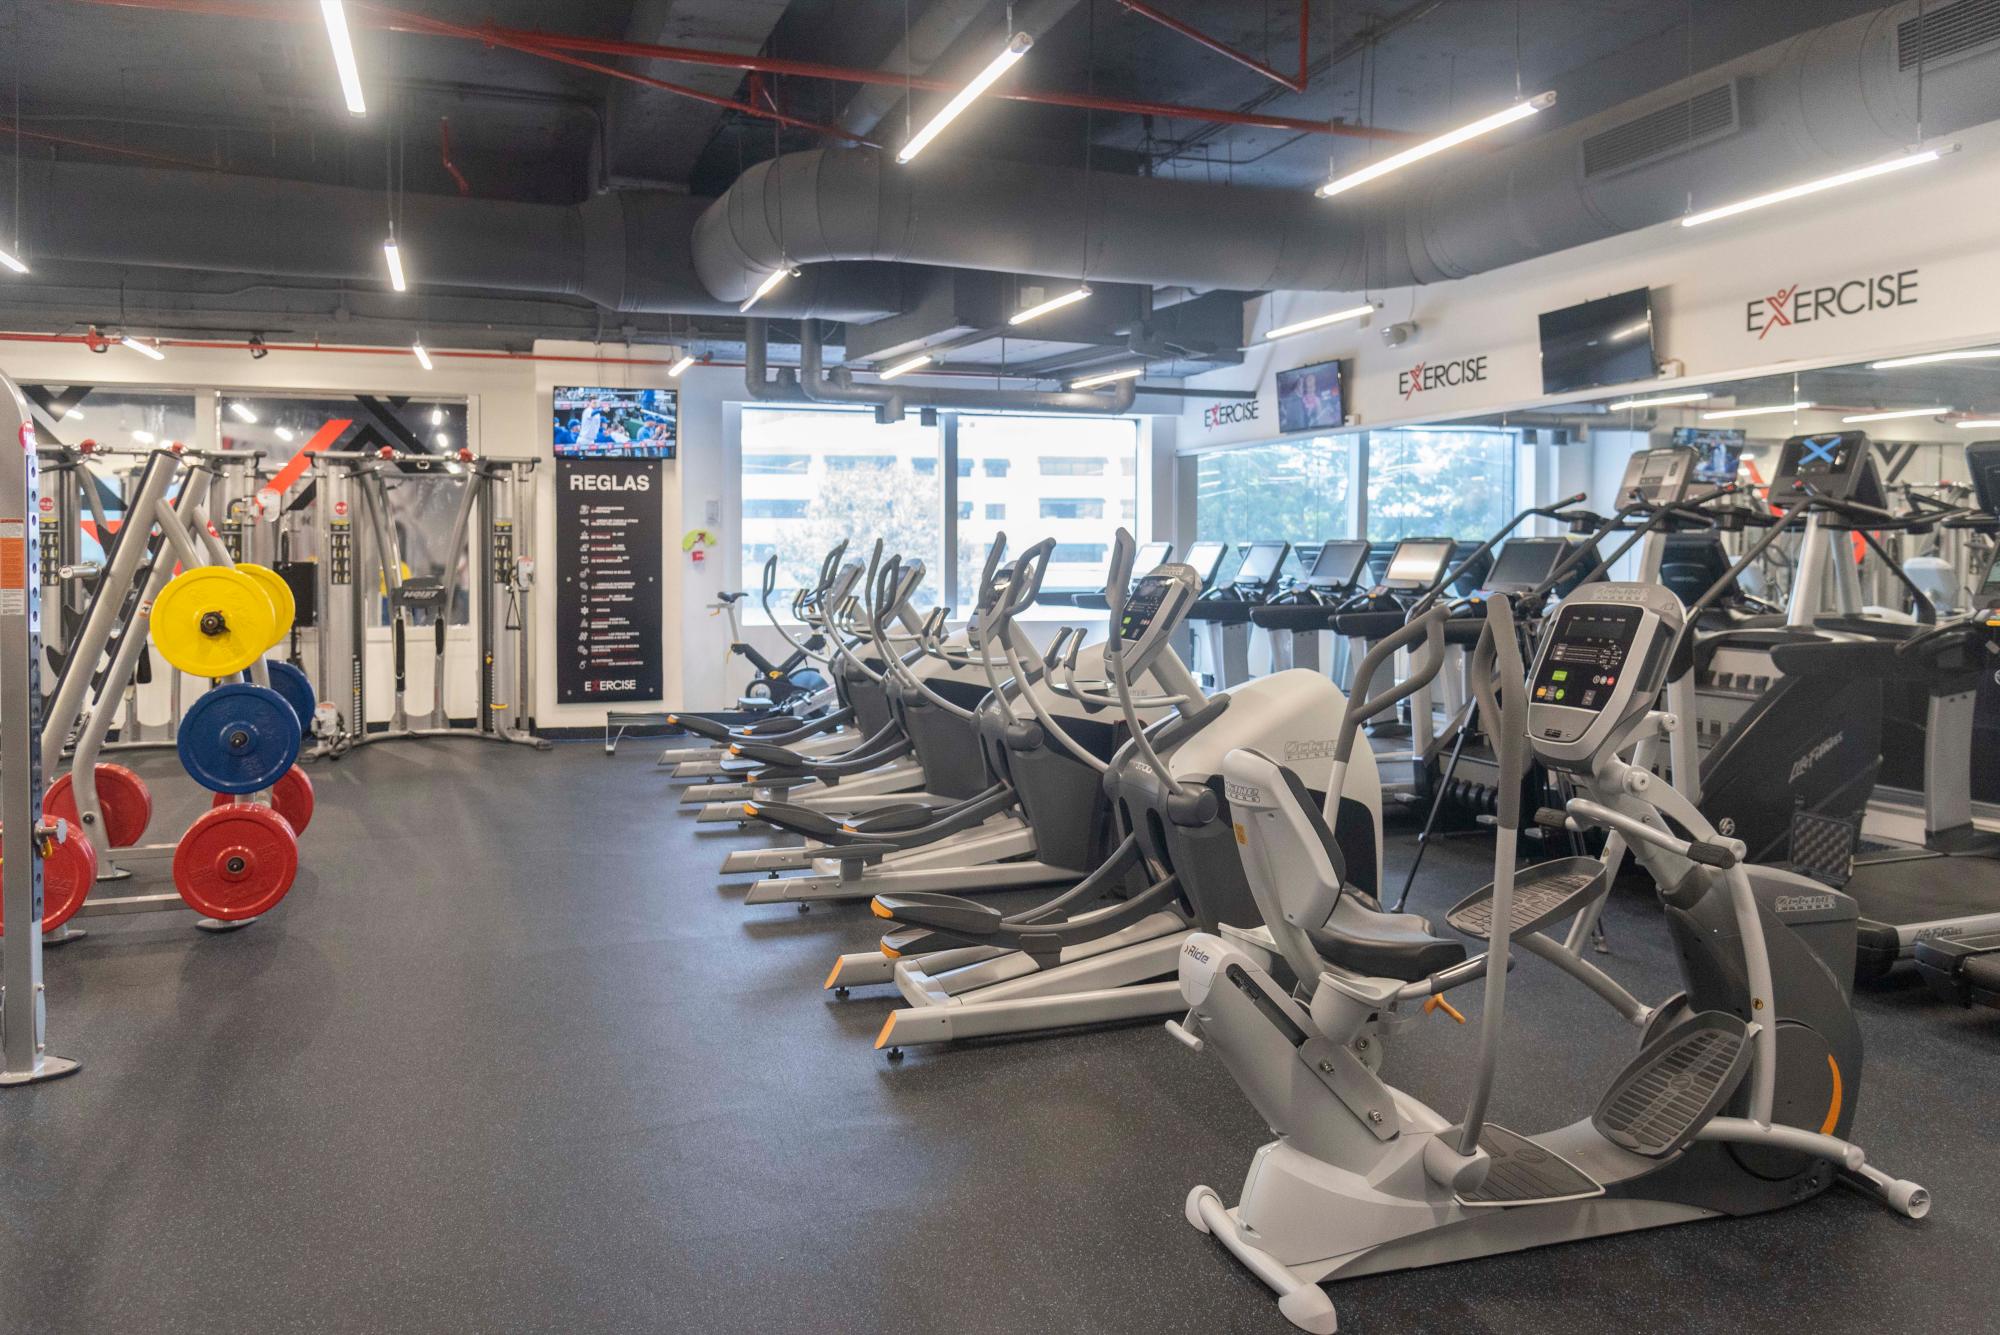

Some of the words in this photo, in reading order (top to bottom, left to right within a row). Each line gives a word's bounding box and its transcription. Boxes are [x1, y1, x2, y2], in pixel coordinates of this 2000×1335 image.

[1746, 269, 1918, 340] EXERCISE
[1399, 356, 1488, 401] EXERCISE
[1204, 400, 1259, 432] EXERCISE
[570, 474, 650, 491] REGLAS
[584, 679, 637, 692] EXERCISE
